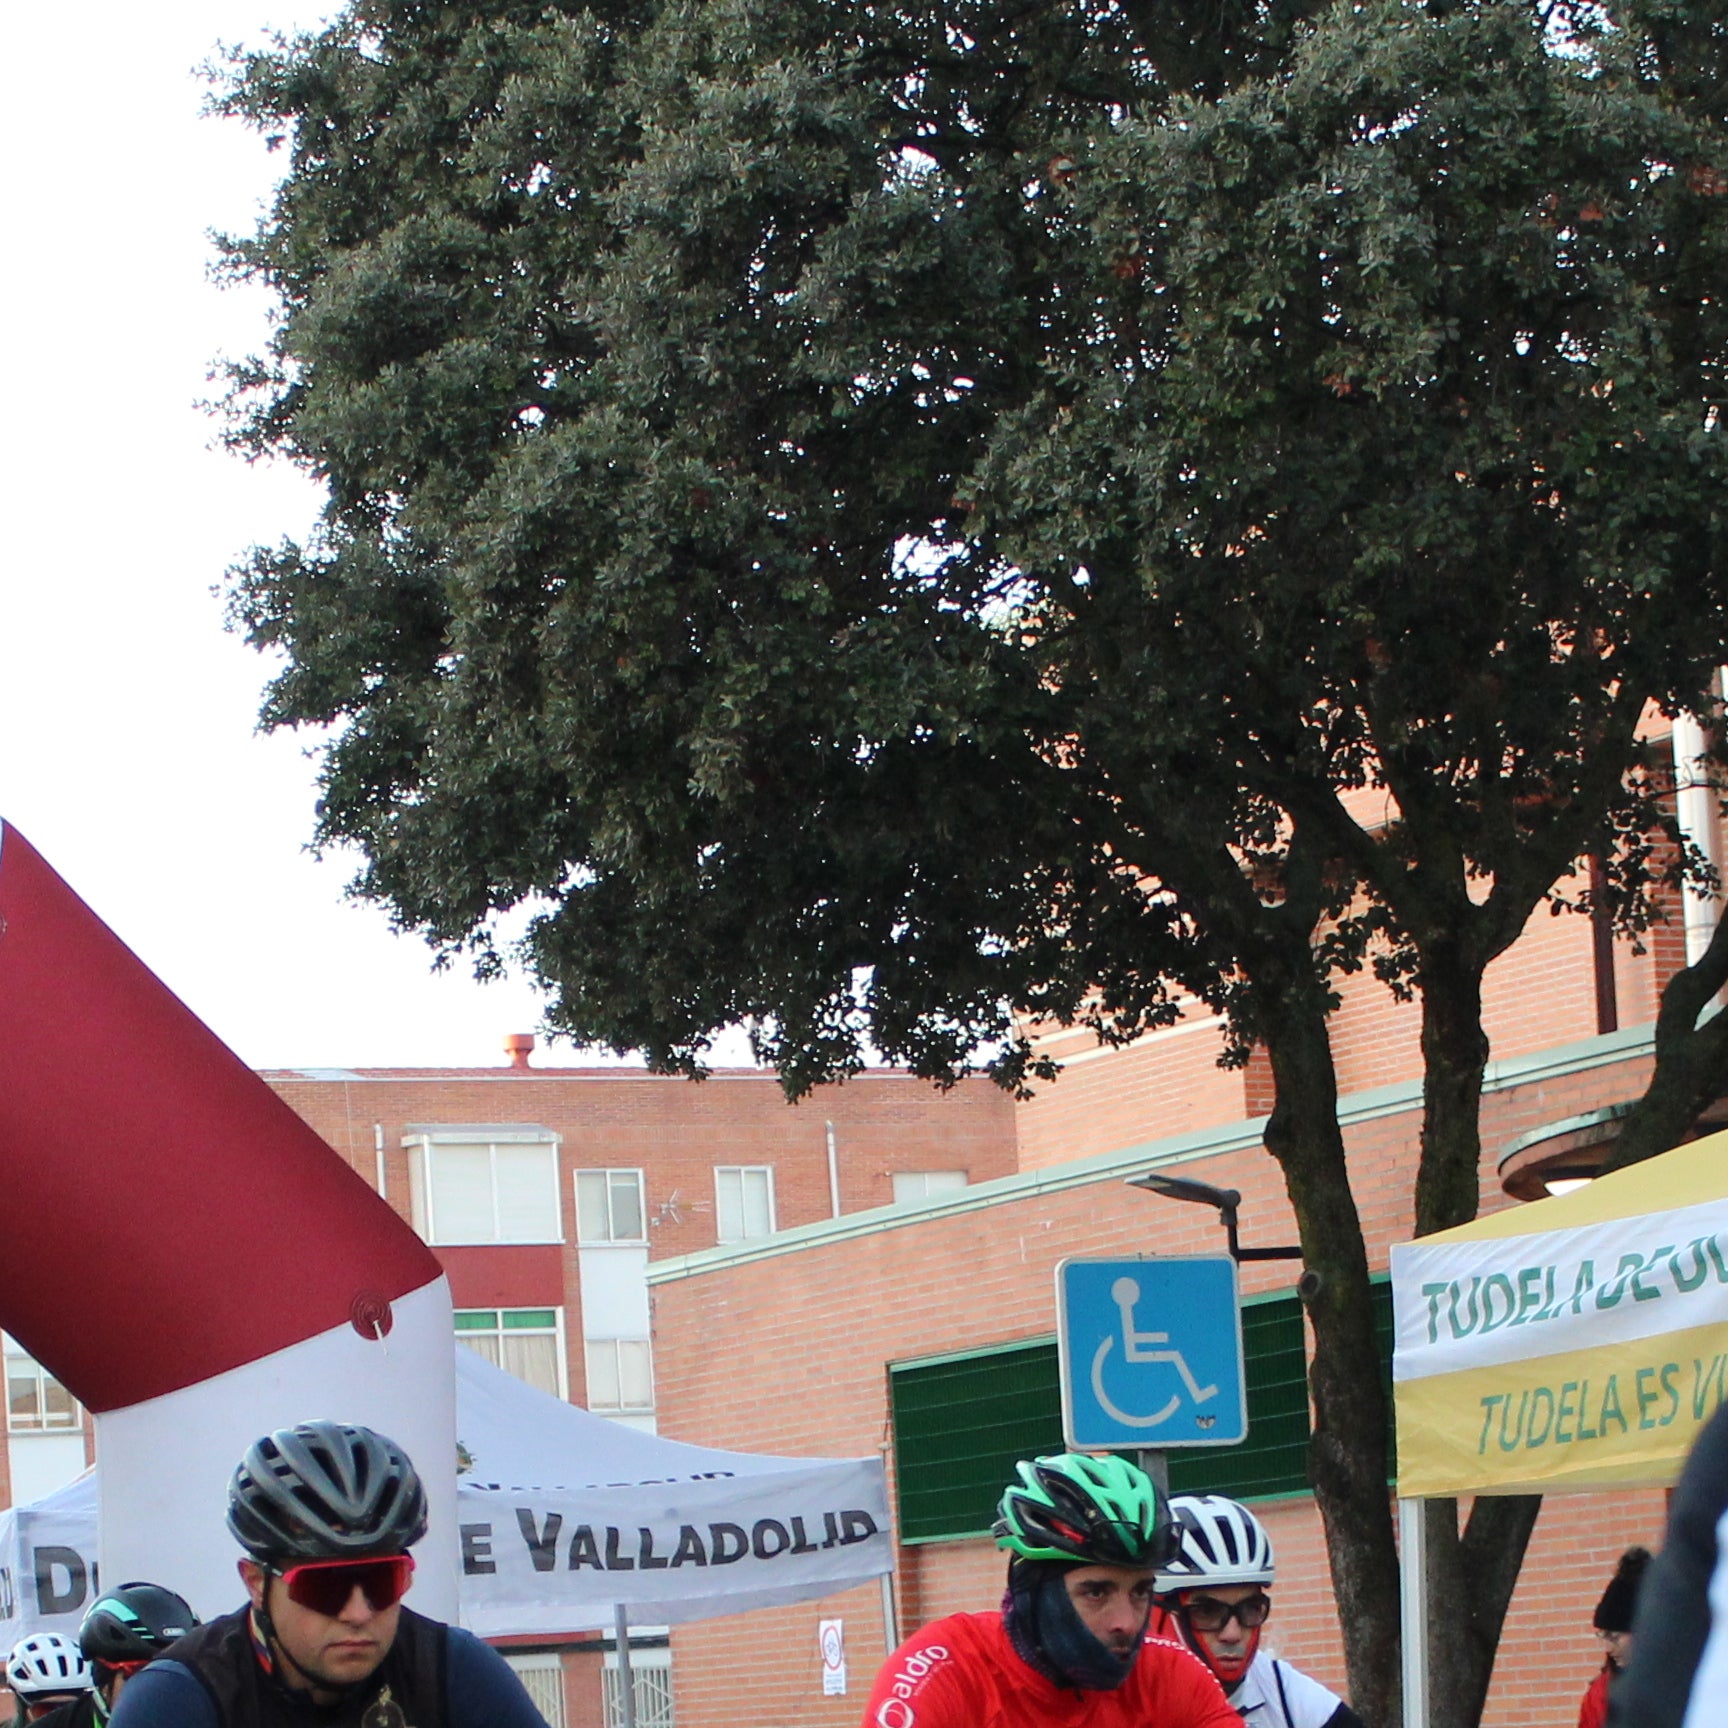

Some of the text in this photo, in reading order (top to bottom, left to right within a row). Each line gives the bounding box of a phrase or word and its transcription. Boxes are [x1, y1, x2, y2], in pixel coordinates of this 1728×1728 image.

[1422, 1259, 1597, 1344] TUDELA
[1475, 1373, 1625, 1455] TUDELA
[1635, 1360, 1681, 1433] ES
[515, 1507, 879, 1574] VALLADOLID
